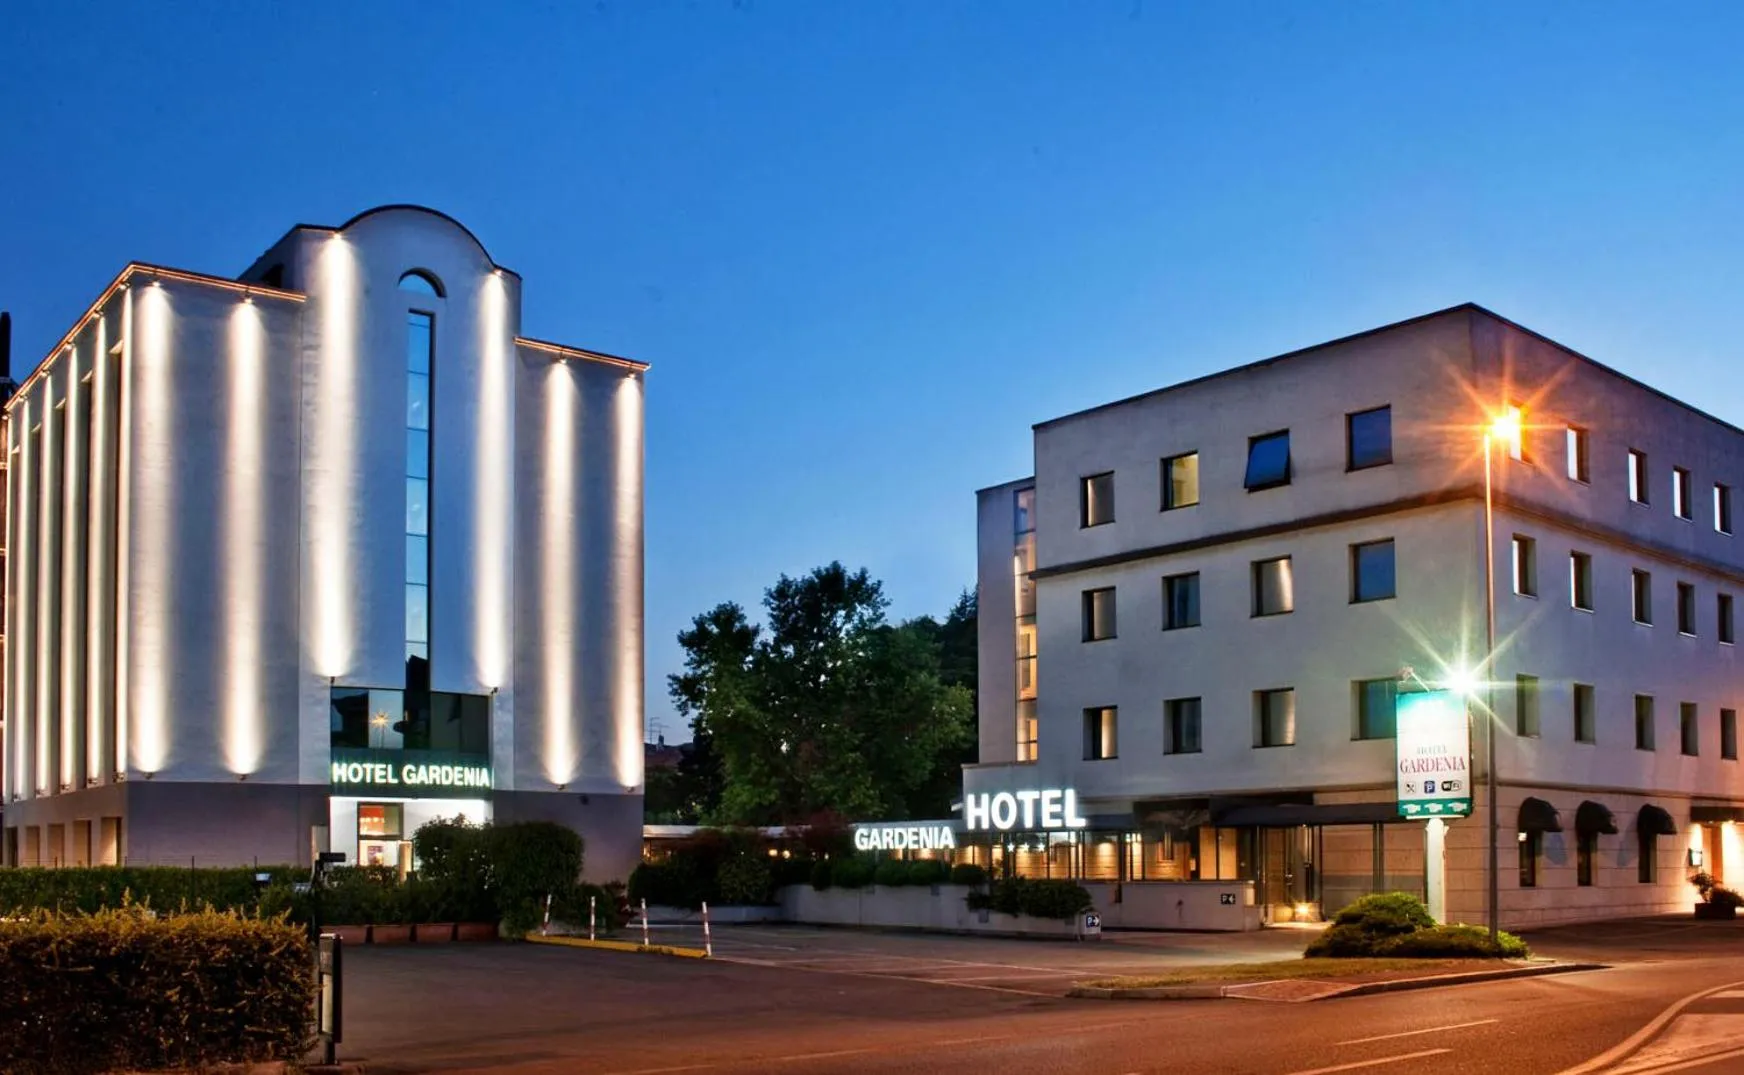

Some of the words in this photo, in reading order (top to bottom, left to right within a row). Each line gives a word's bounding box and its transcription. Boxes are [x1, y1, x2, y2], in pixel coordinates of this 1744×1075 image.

[332, 762, 398, 784] HOTEL
[402, 764, 490, 786] GARDENIA
[1400, 756, 1465, 774] GARDENIA
[966, 789, 1087, 830] HOTEL
[854, 826, 955, 850] GARDENIA
